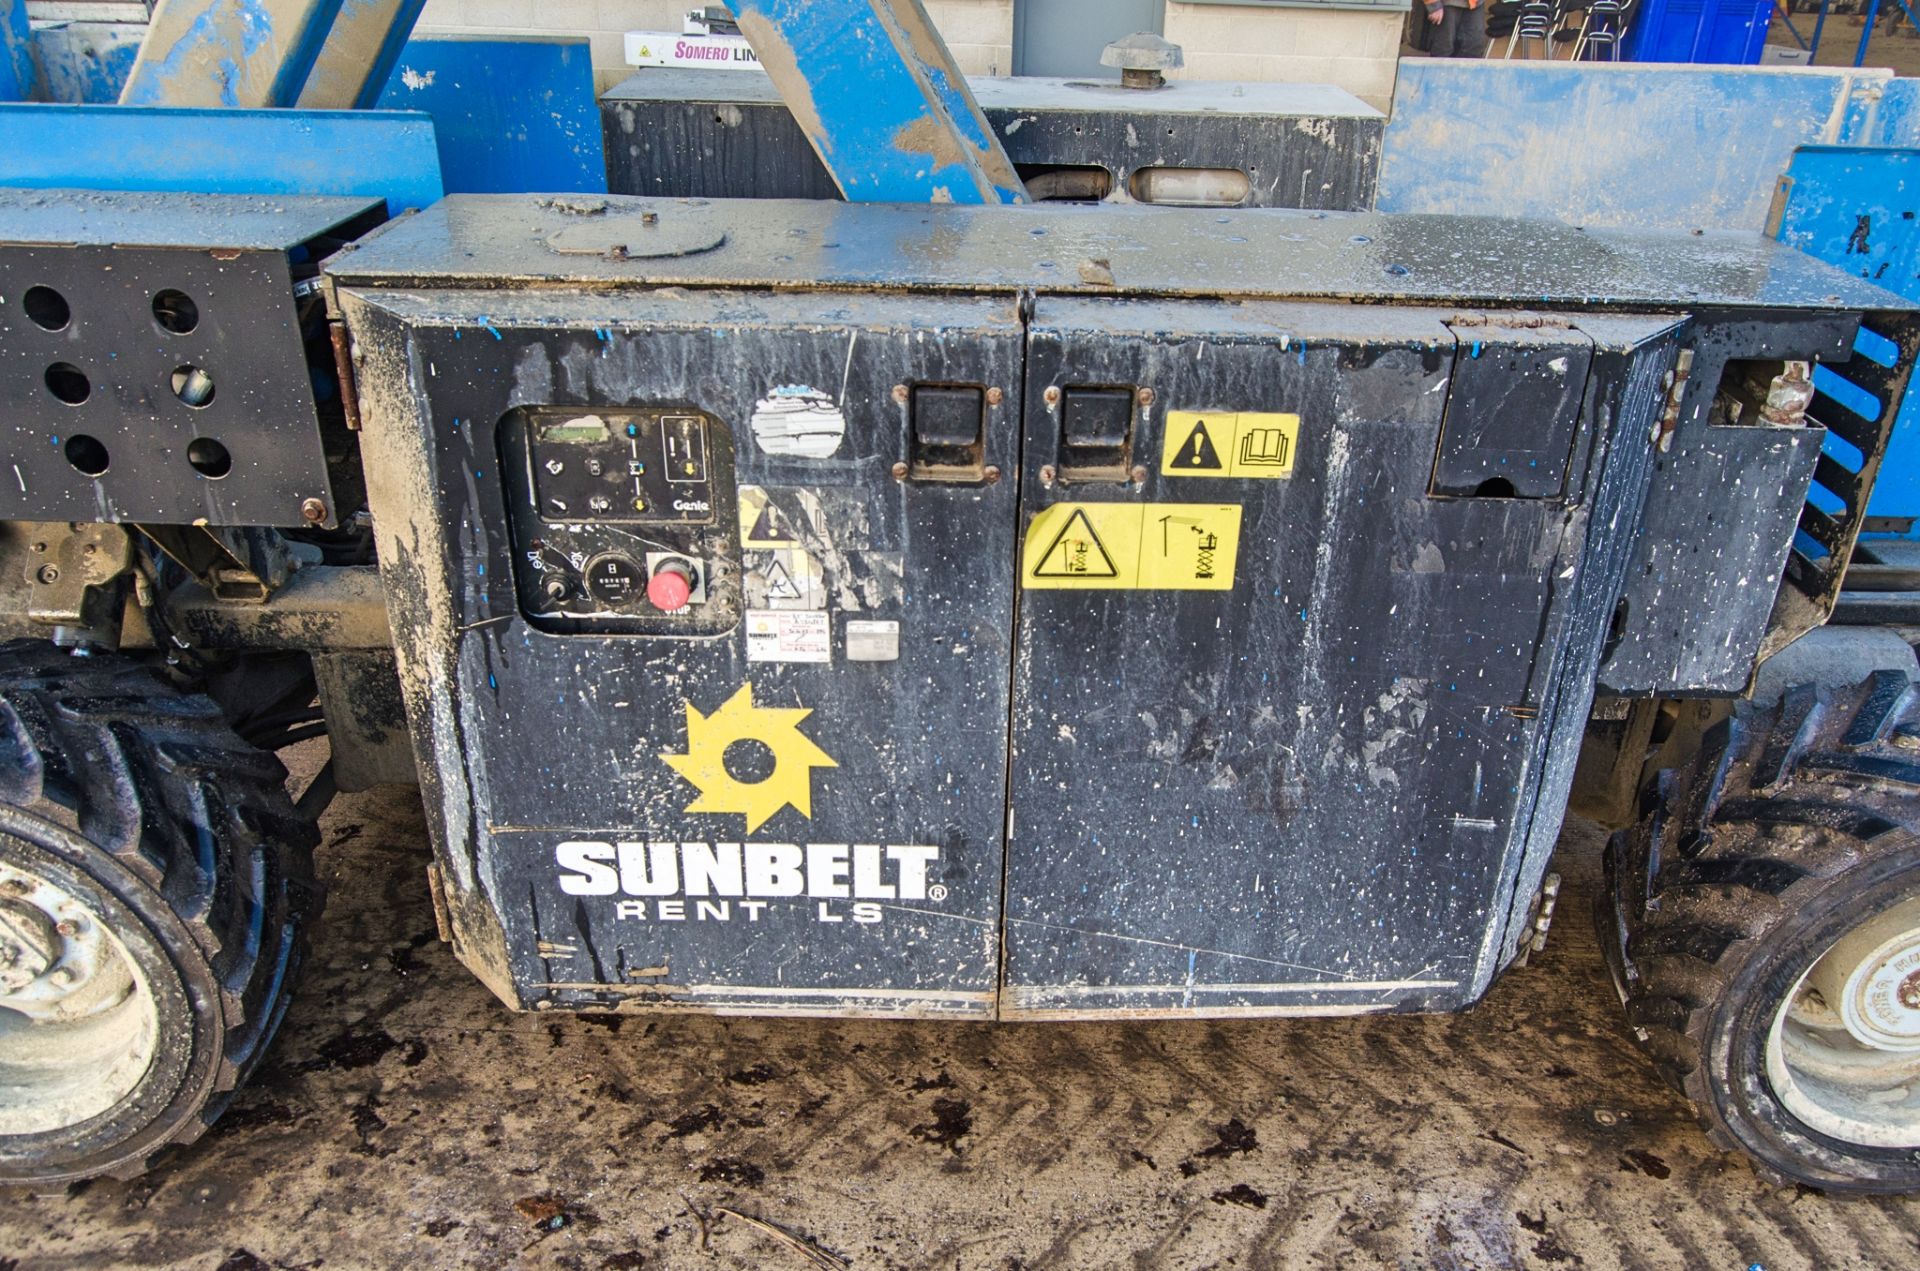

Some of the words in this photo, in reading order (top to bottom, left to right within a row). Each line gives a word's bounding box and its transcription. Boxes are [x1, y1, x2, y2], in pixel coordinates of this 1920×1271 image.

[674, 41, 729, 61] SOMERO
[733, 48, 760, 62] LIN
[673, 499, 711, 511] Genie
